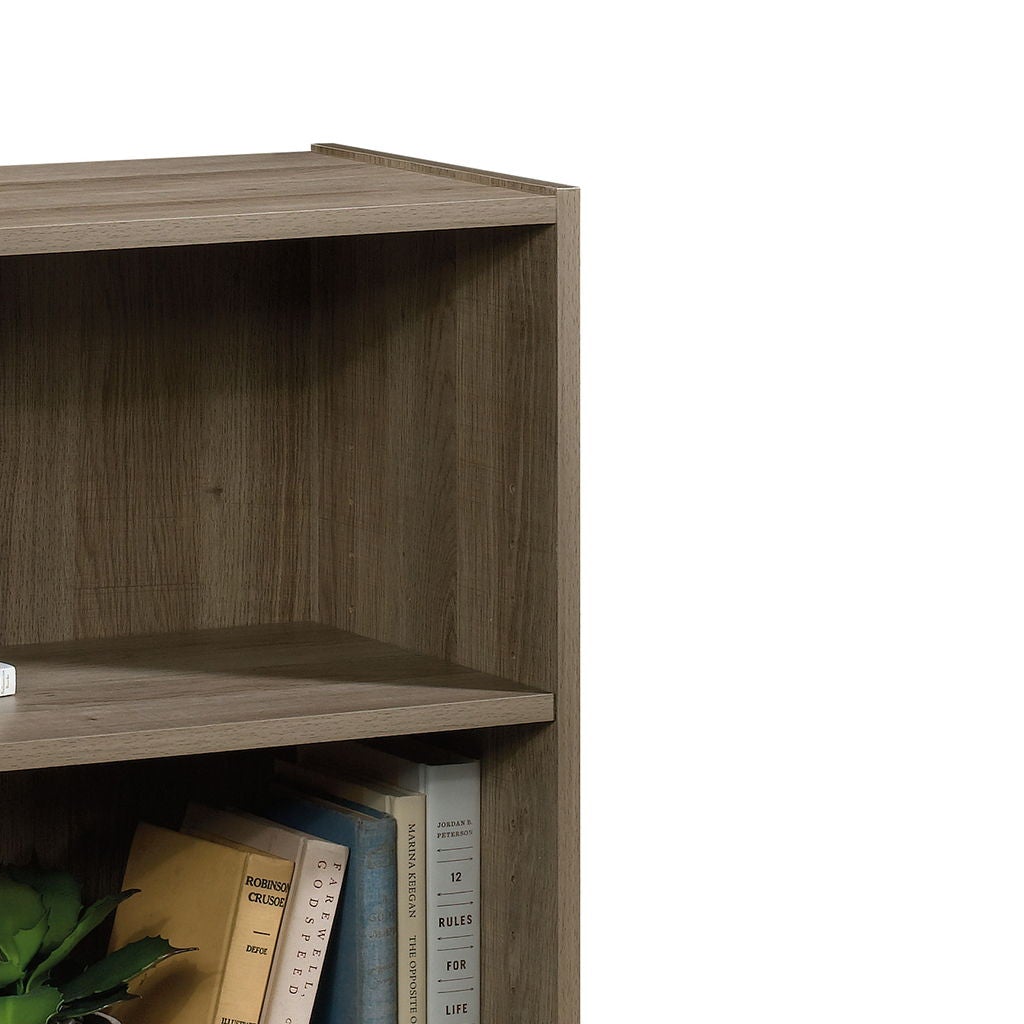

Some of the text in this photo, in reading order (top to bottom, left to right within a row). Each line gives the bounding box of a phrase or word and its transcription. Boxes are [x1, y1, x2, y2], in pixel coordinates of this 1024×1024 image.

[437, 820, 465, 829] JORDAN
[408, 823, 416, 869] MARINA
[450, 871, 462, 882] 12
[248, 892, 285, 908] CRUSOE
[408, 872, 416, 918] KEEGAN
[289, 860, 327, 994] GODSPEED
[438, 914, 473, 927] RULES
[245, 944, 268, 955] DEFOE
[409, 935, 417, 958] THE
[446, 959, 466, 971] FOR
[409, 961, 418, 1013] OPPOSITE
[446, 1003, 468, 1015] LIFE
